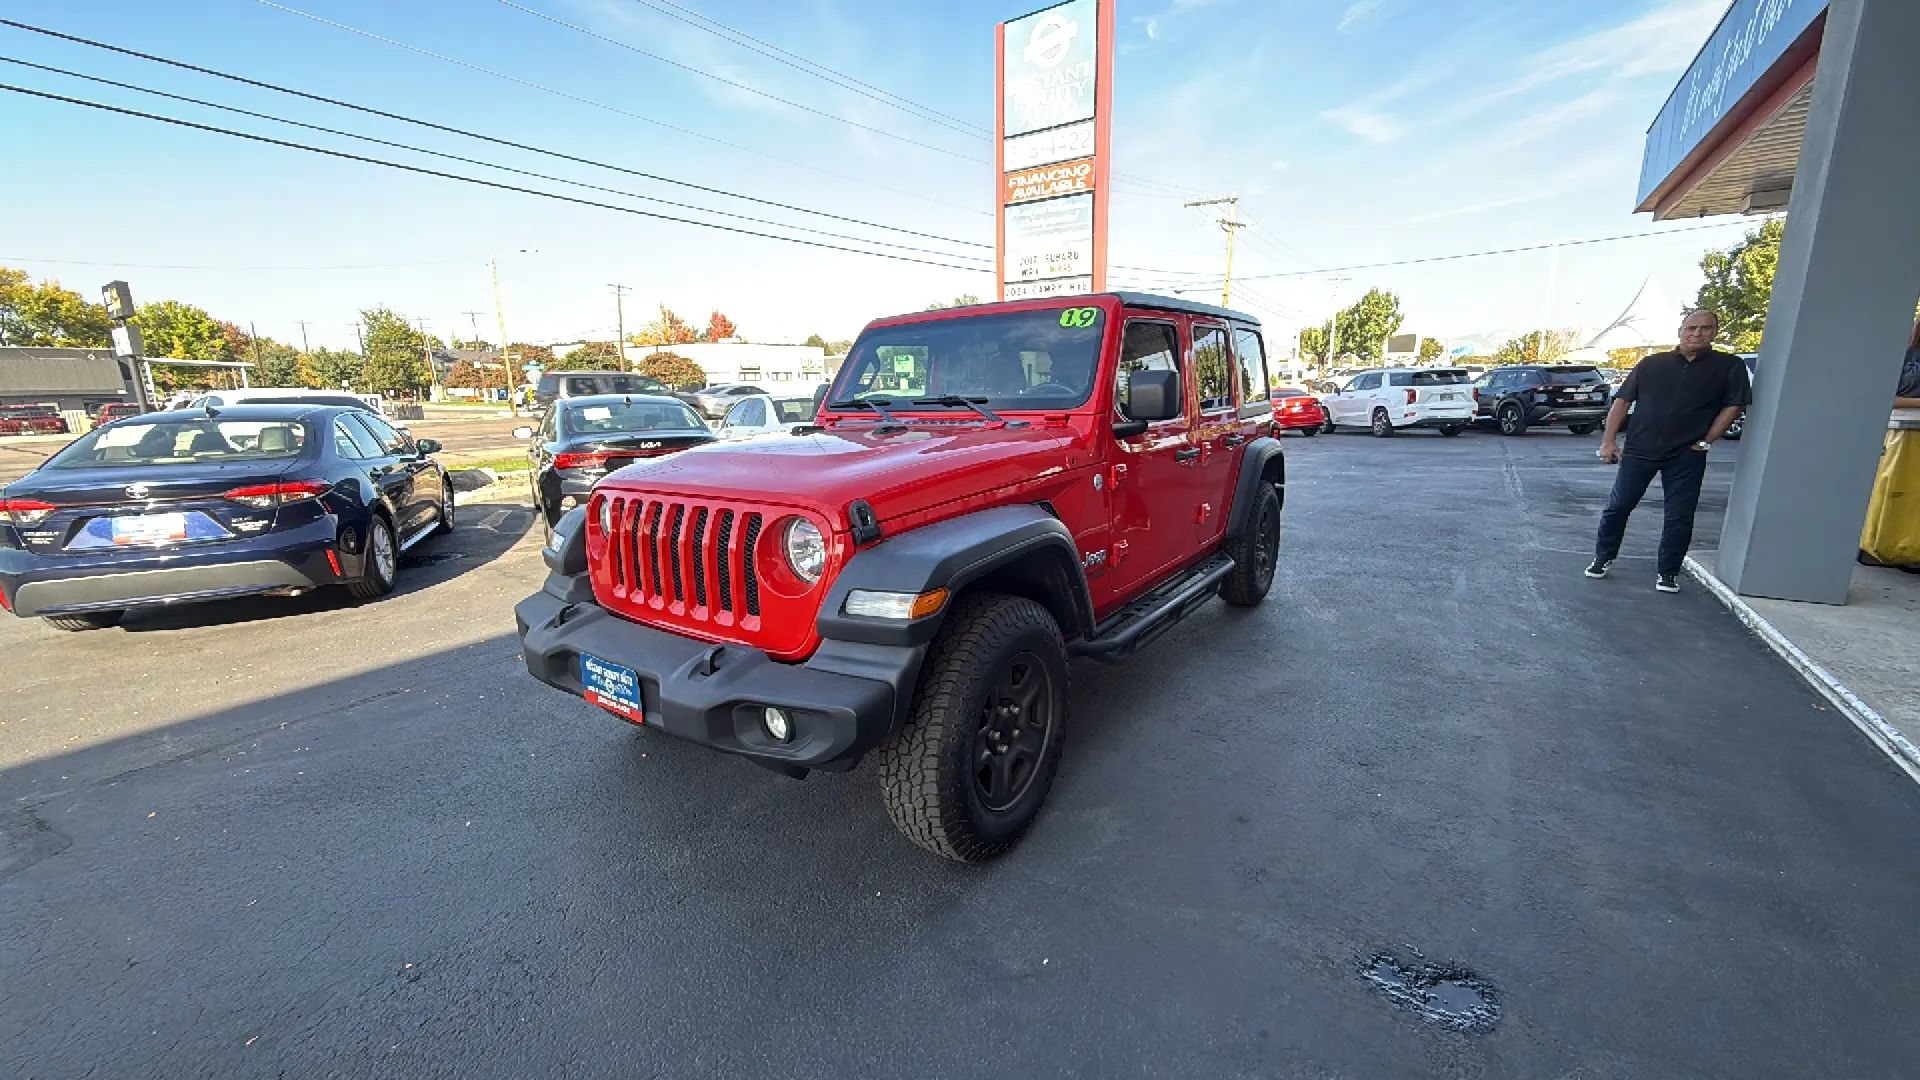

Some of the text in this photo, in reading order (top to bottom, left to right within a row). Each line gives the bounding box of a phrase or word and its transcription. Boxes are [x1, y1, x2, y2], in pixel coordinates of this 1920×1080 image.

[1007, 163, 1091, 189] FINANCING
[1011, 176, 1088, 200] AVAILABLE
[1044, 250, 1079, 263] SUBARU
[1060, 307, 1097, 328] 19
